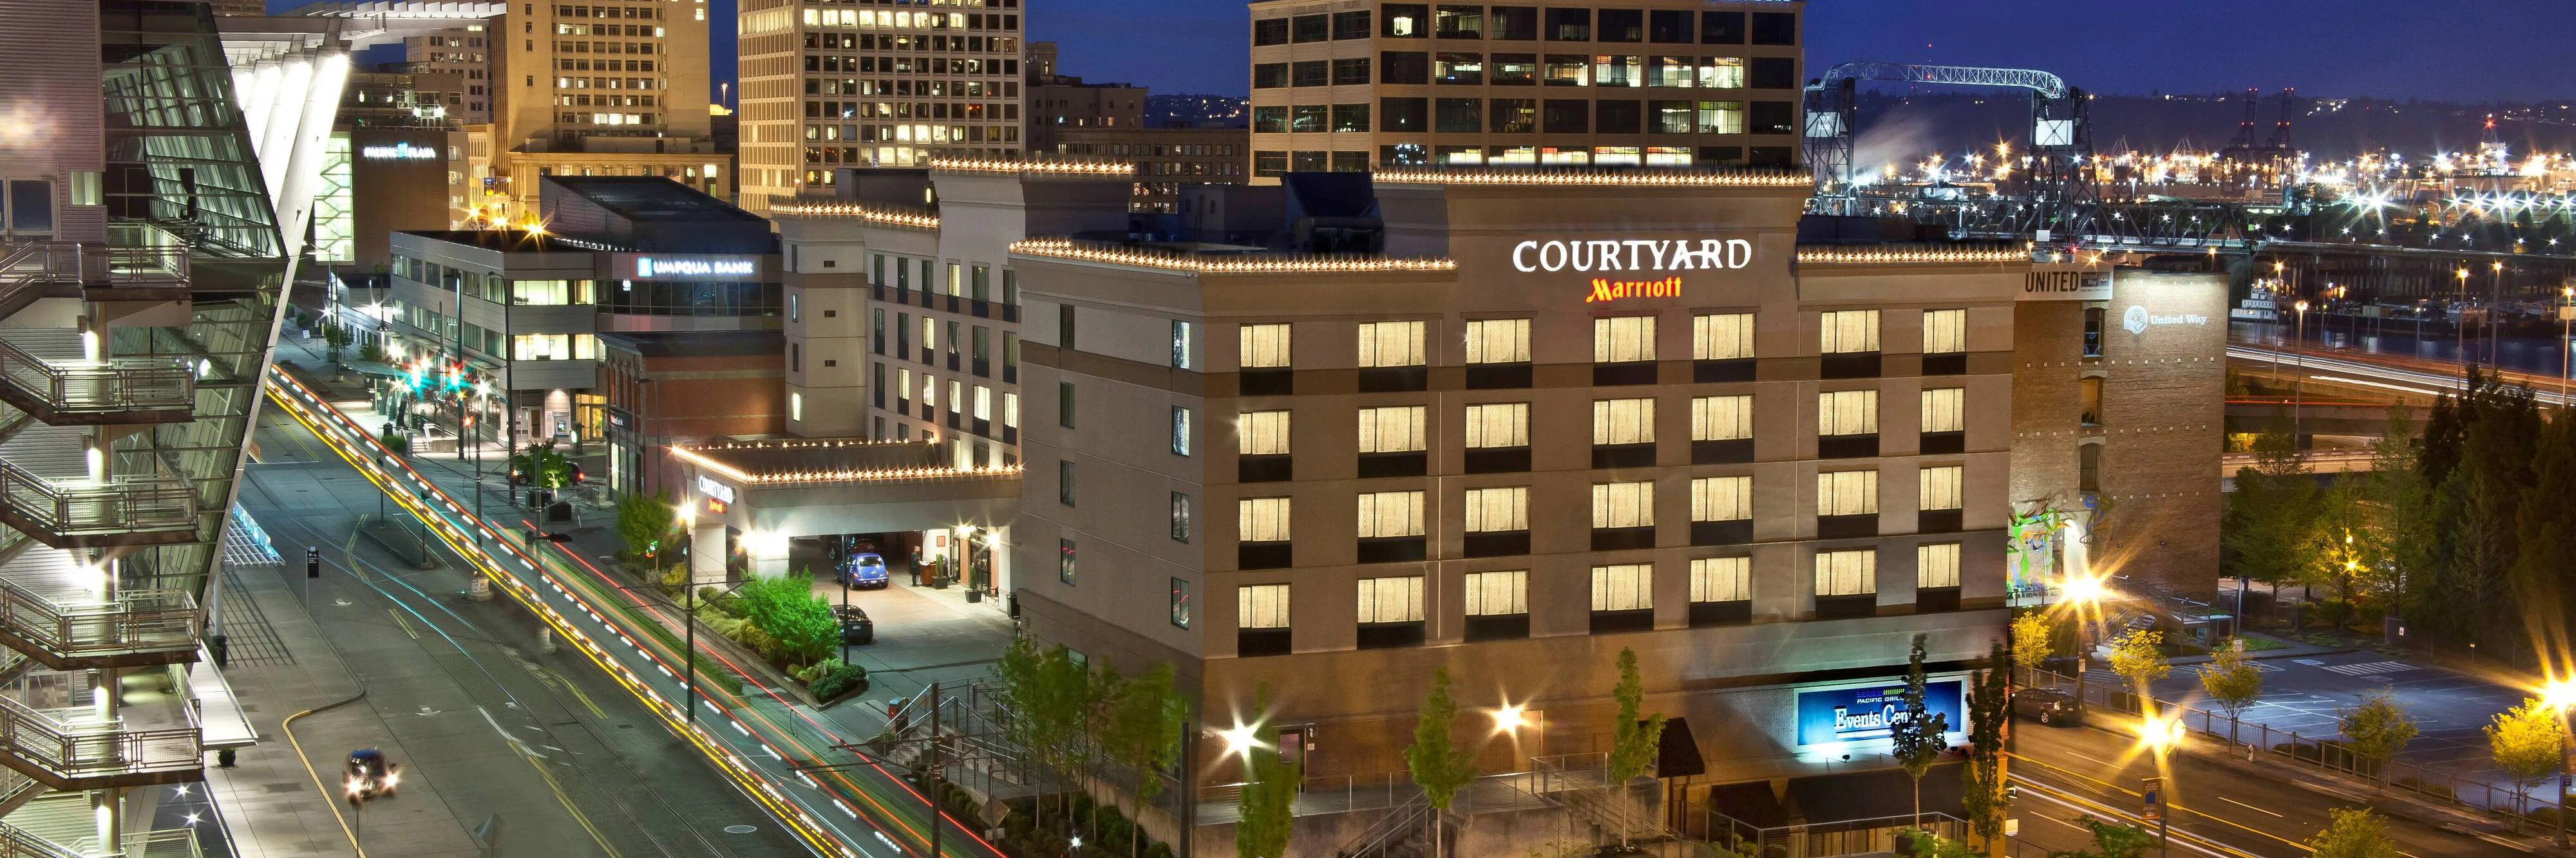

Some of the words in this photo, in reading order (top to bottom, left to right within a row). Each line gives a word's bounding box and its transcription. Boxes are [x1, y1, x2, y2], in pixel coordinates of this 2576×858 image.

[653, 260, 712, 274] UMPQUA
[714, 261, 753, 274] BANK
[1513, 239, 1752, 272] COURTYARD
[1586, 277, 1681, 303] Marriott
[2025, 271, 2079, 292] UNITED
[2150, 315, 2184, 324] United
[2185, 314, 2208, 325] Way
[699, 474, 733, 504] COURTYARD
[1834, 708, 1881, 729] Events
[1882, 704, 1927, 725] Cen
